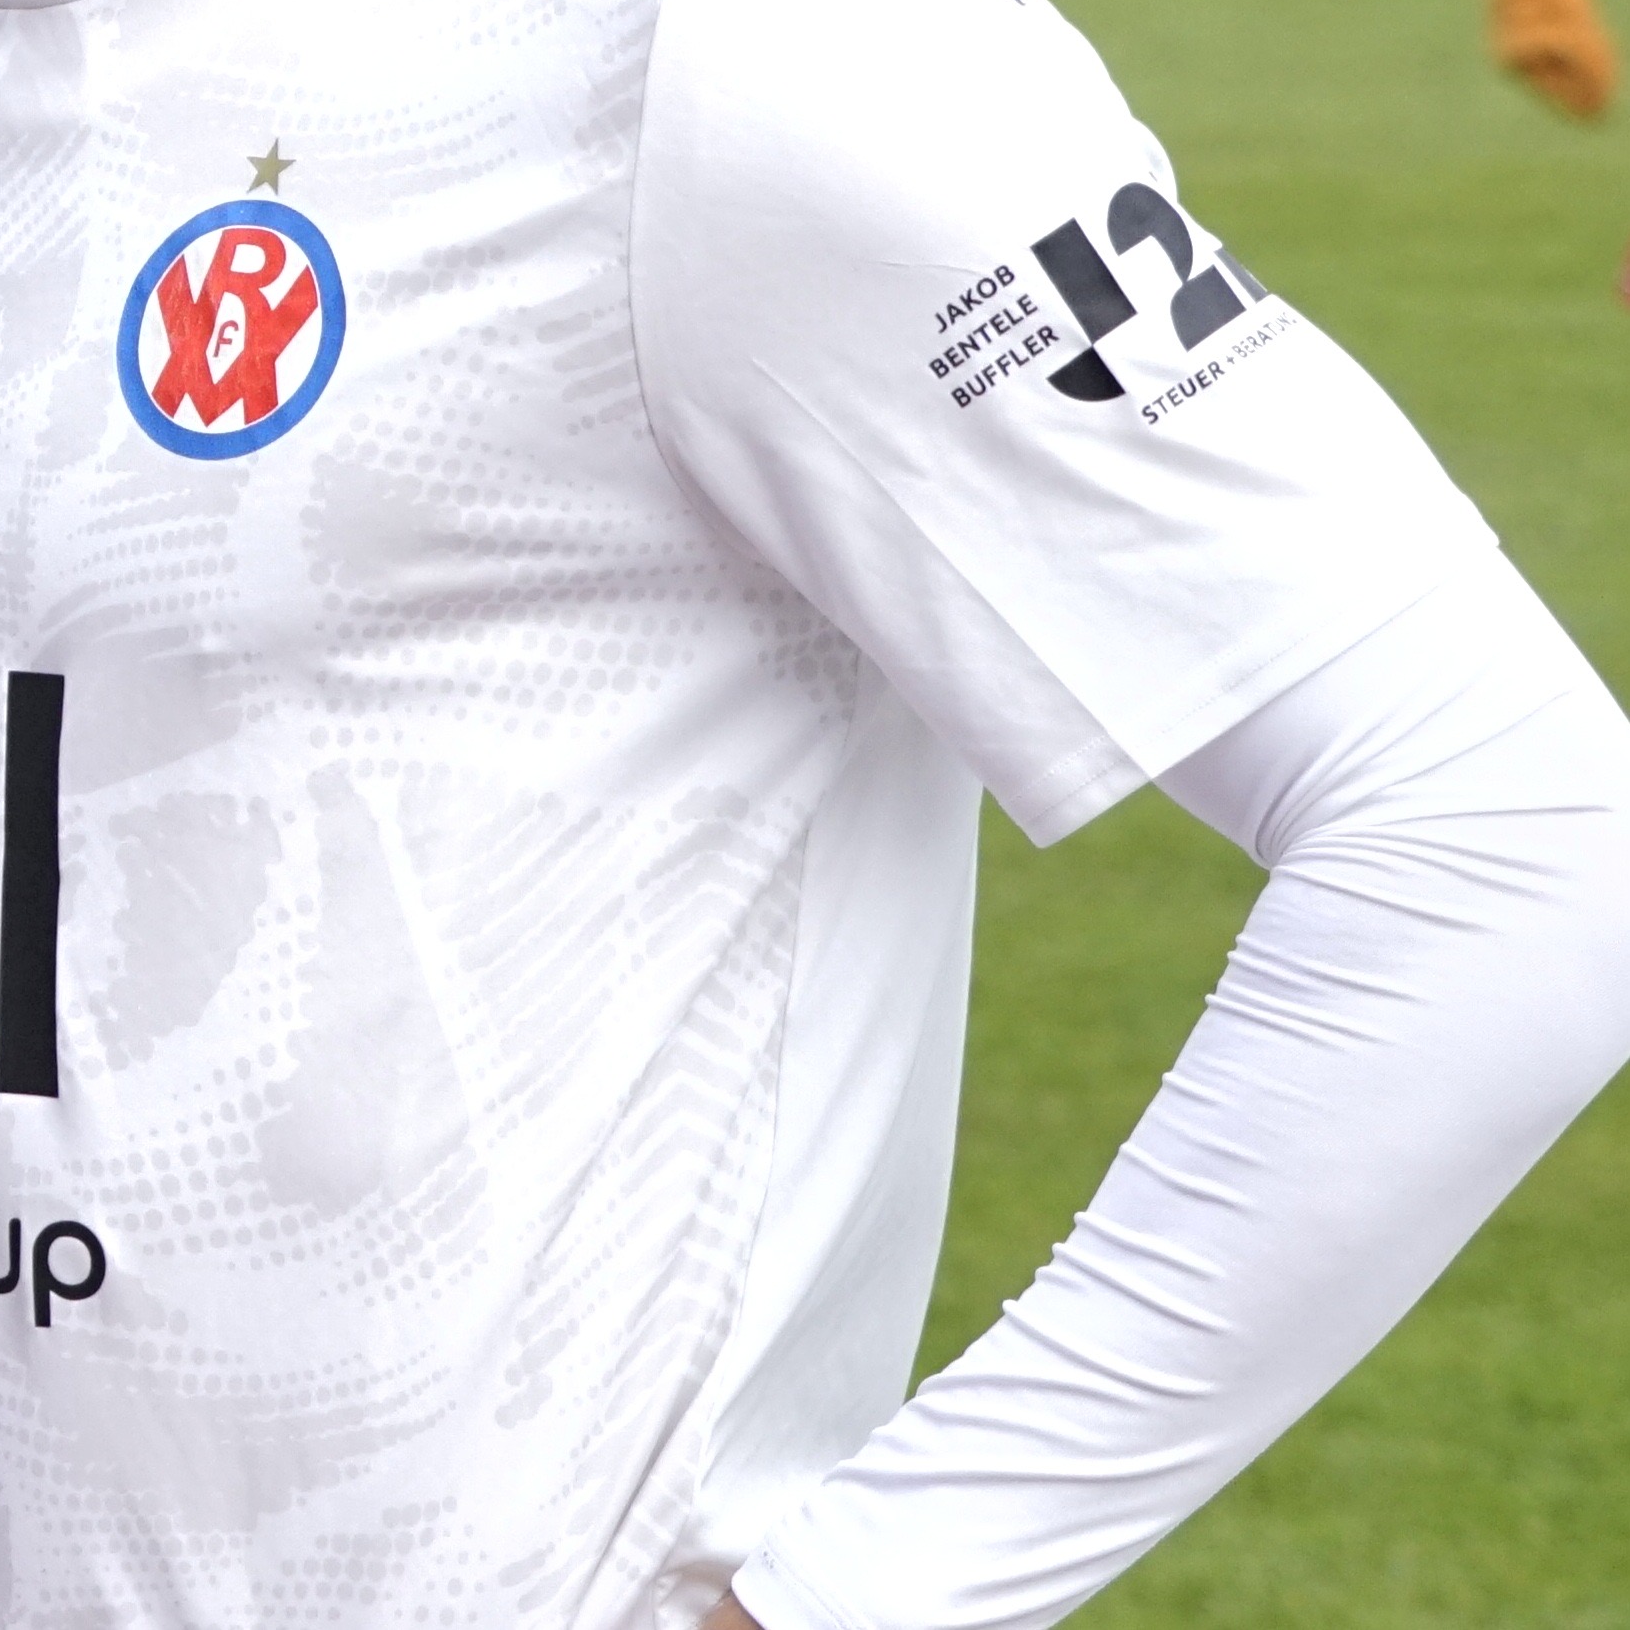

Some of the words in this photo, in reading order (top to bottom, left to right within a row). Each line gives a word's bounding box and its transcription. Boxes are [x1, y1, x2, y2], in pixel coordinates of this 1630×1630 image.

[929, 293, 1039, 380] BENTELE
[935, 265, 1016, 334] JAKOB
[951, 325, 1060, 409] BUFFLER
[1141, 360, 1225, 425] STEUER
[1231, 311, 1298, 359] BERATUN
